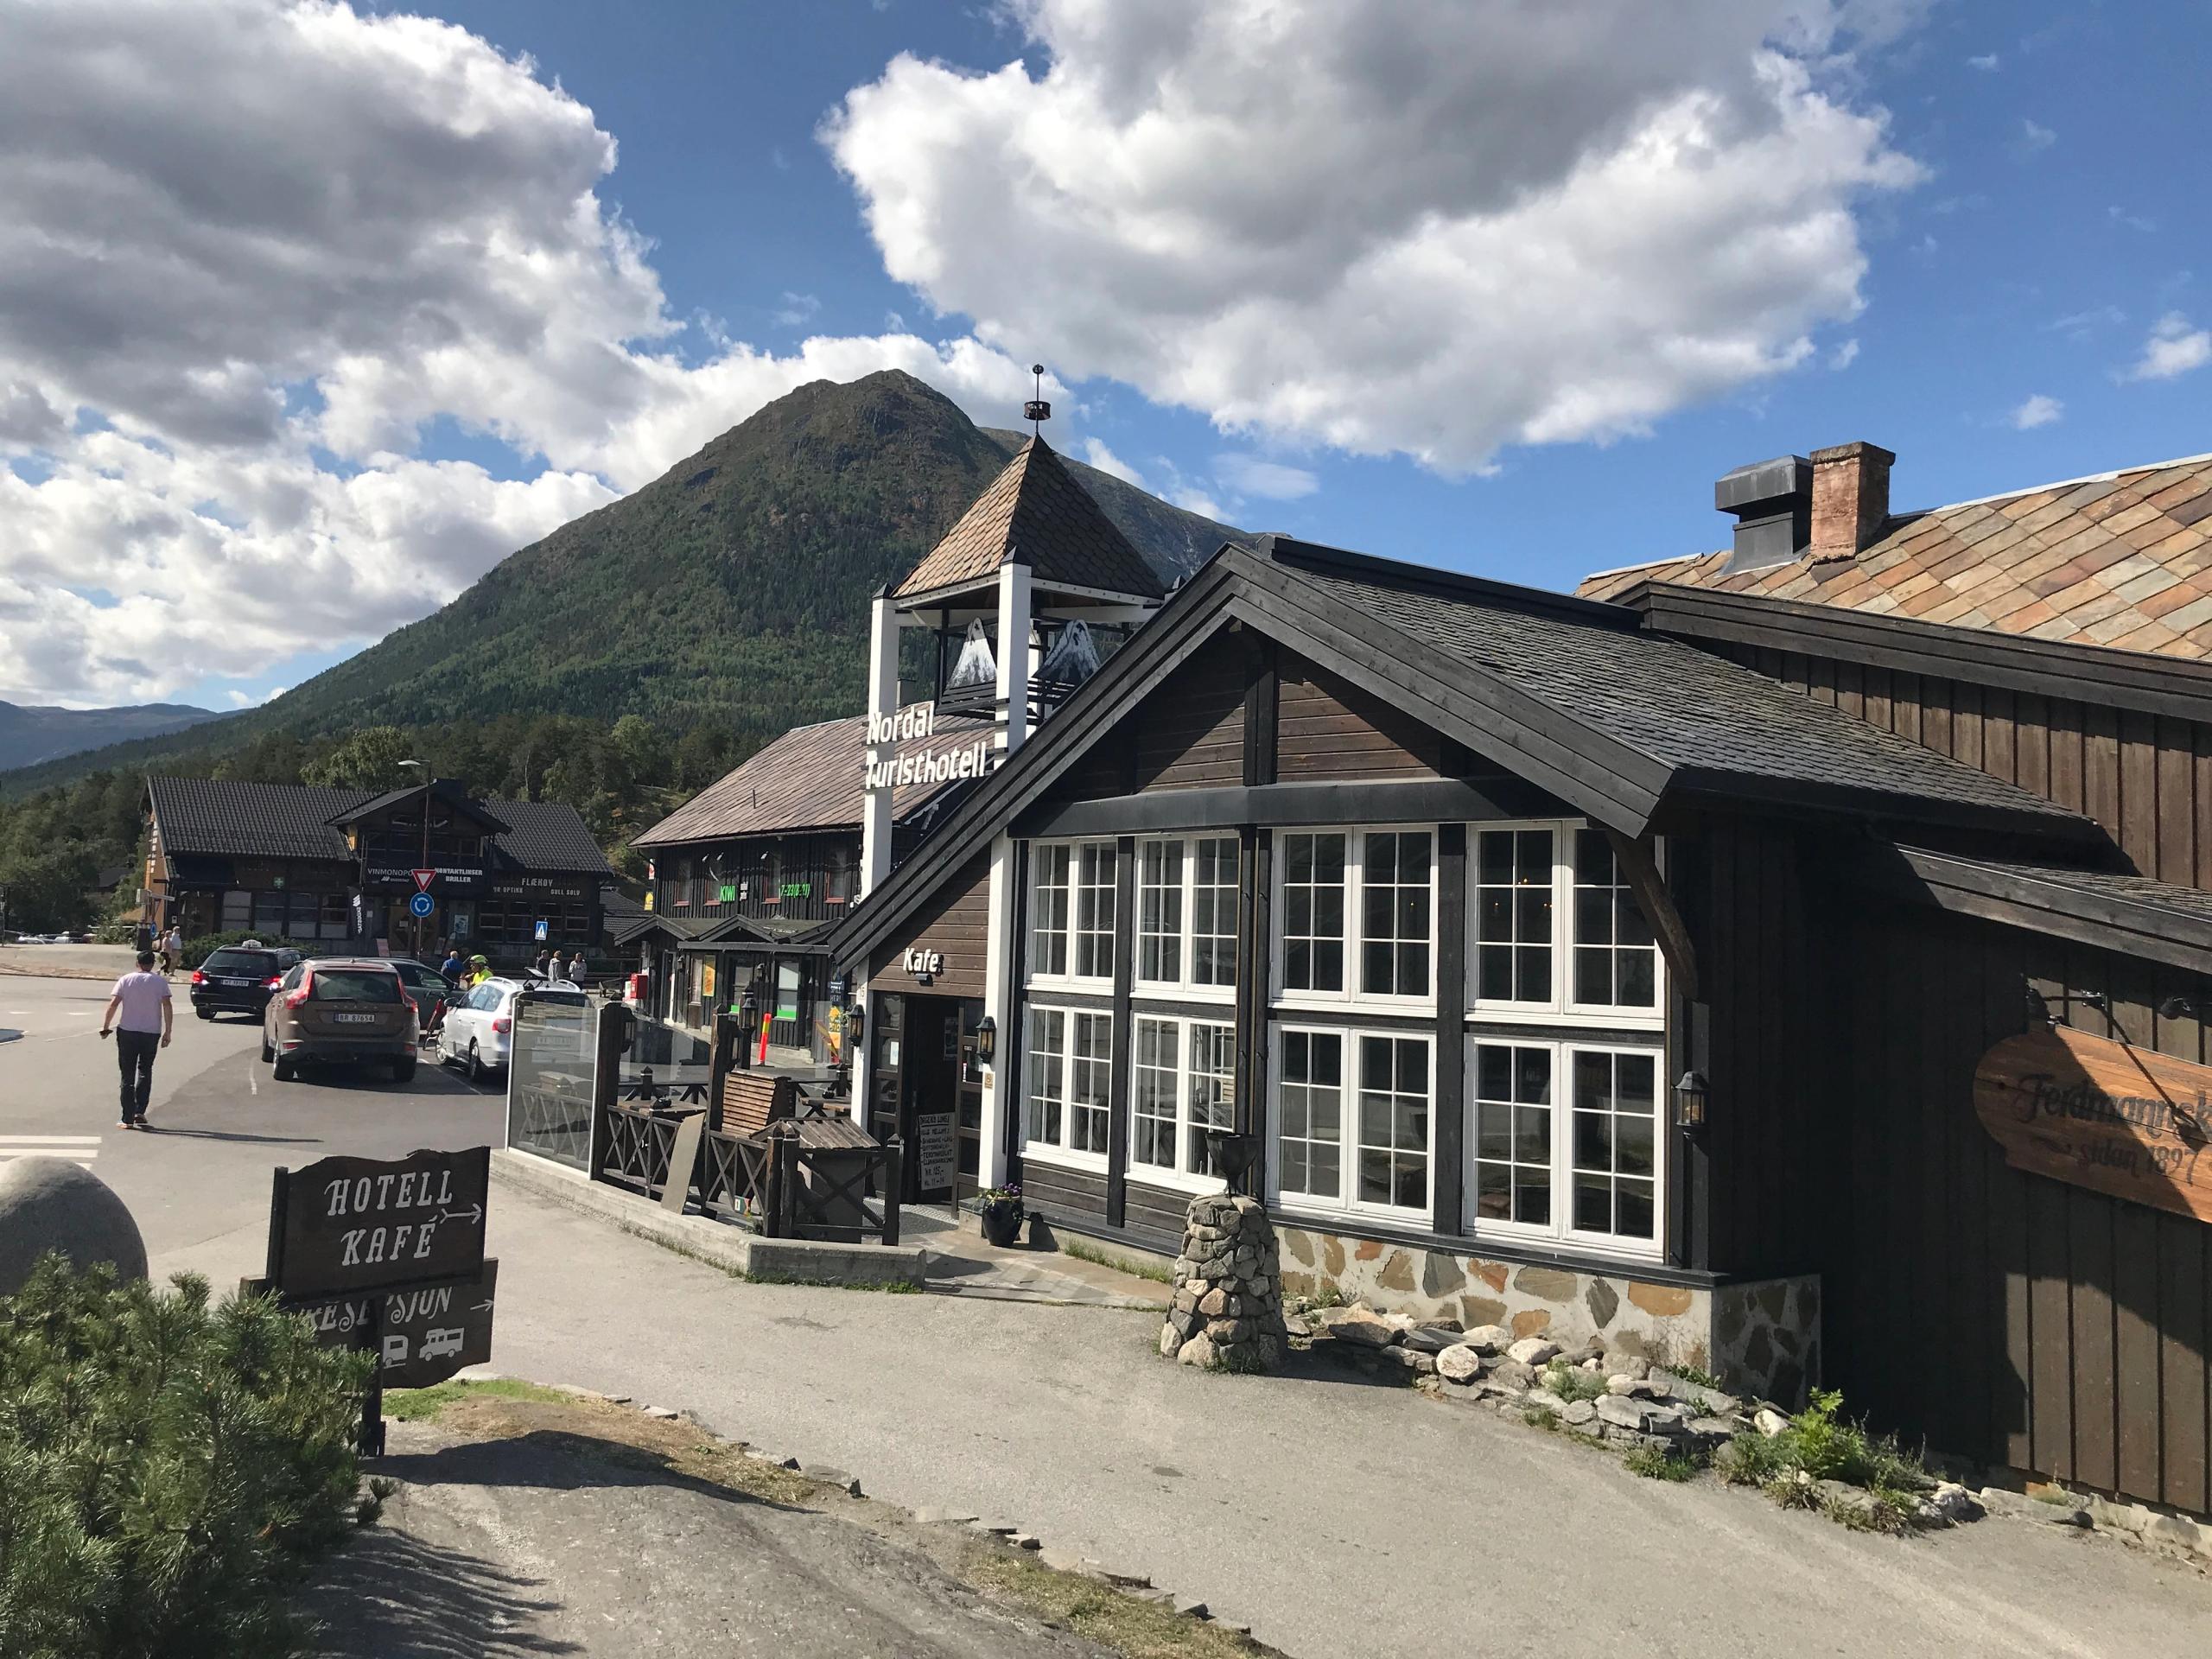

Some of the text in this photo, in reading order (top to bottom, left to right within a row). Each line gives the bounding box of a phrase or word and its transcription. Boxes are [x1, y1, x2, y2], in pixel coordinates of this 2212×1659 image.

[867, 701, 935, 745] Nordal
[865, 741, 987, 790] Turisthotell
[720, 886, 736, 902] KIWI
[903, 947, 939, 972] Kafe
[324, 1170, 453, 1217] HOTELL
[340, 1215, 438, 1267] KAFÉ
